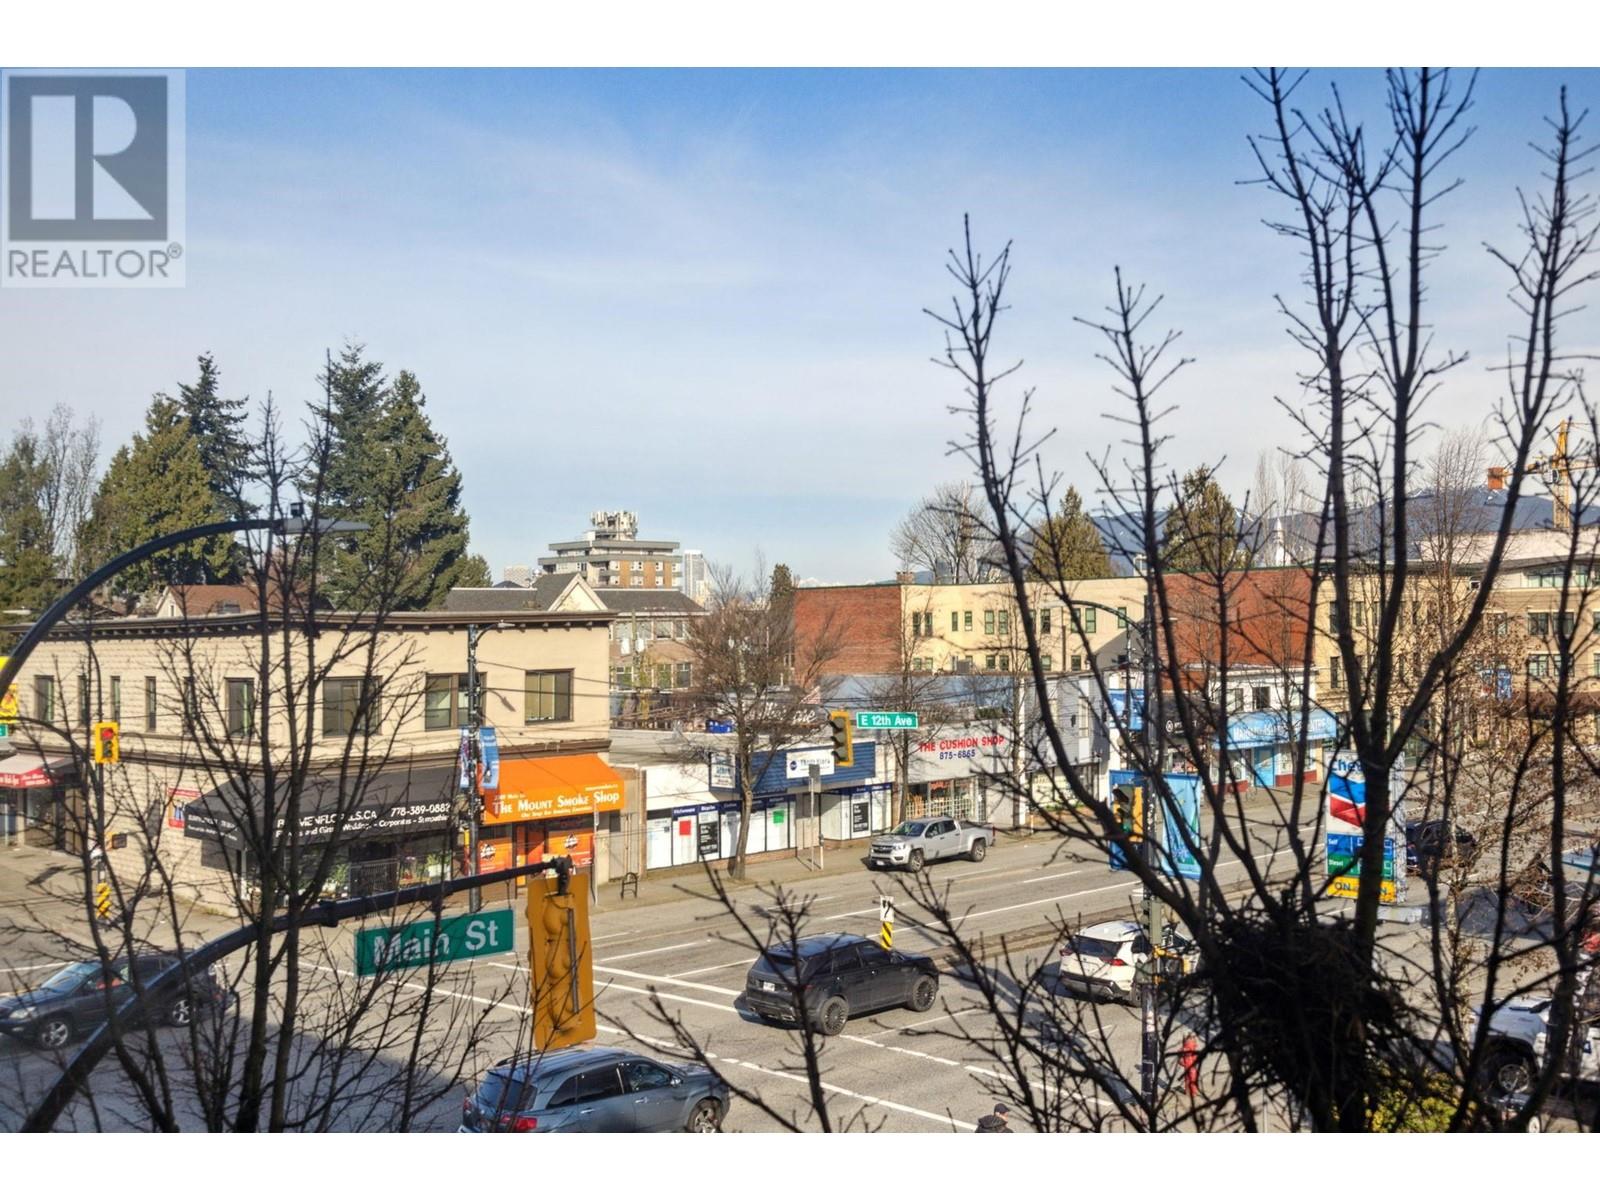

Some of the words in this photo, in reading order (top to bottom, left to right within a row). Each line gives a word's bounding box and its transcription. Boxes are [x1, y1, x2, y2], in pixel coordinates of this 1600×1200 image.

[861, 716, 868, 726] E
[872, 715, 891, 726] 12th
[895, 715, 913, 726] Ave
[919, 741, 937, 753] THE
[939, 738, 979, 751] CUSHION
[981, 735, 1005, 746] SHOP
[1328, 859, 1344, 867] Diesel
[373, 928, 450, 967] Main
[464, 919, 499, 951] St
